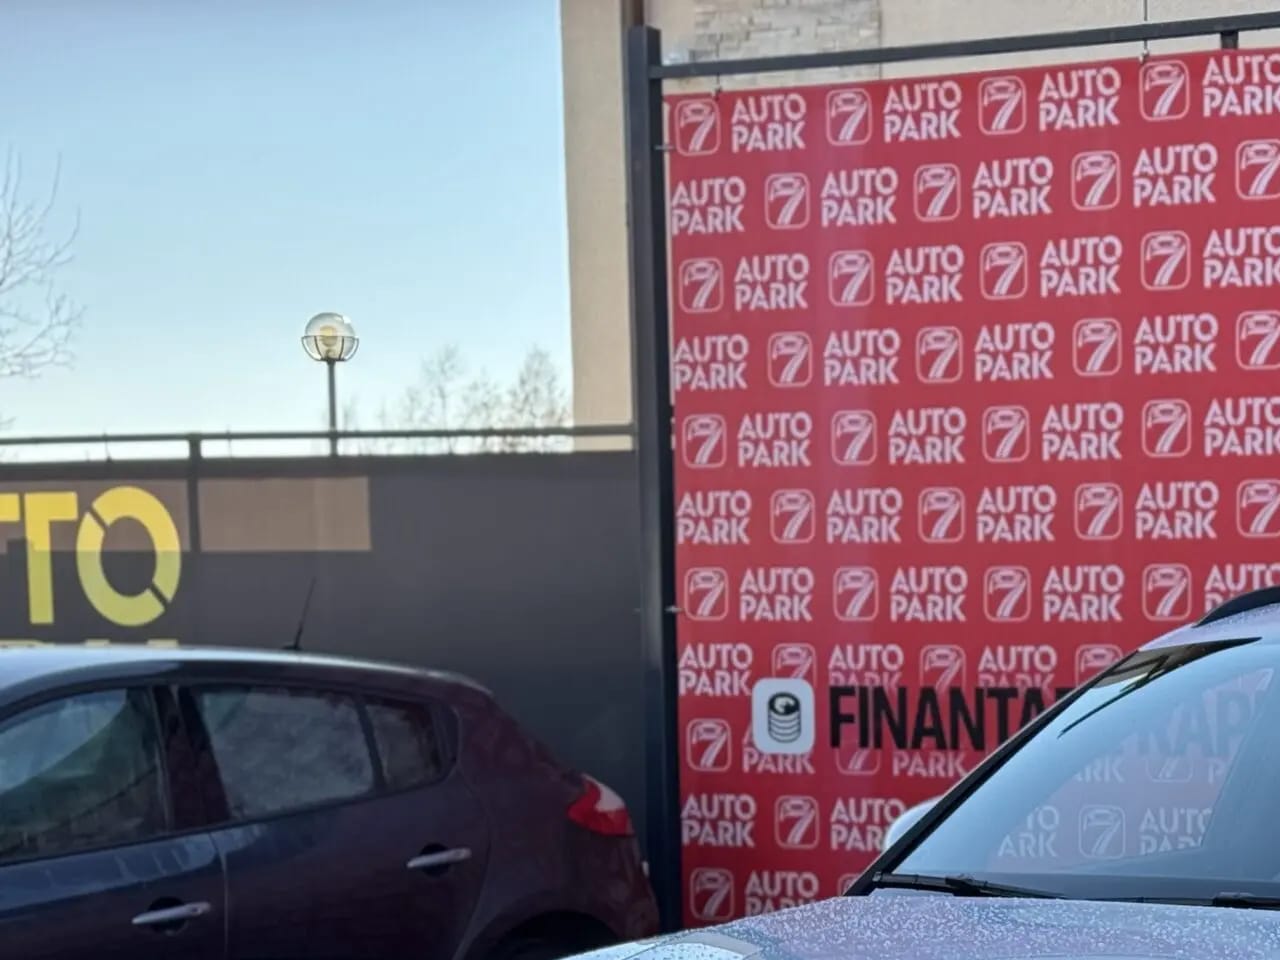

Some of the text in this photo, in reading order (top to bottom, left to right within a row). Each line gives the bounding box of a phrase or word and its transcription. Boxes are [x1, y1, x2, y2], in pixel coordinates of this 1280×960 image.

[883, 80, 962, 113] AUTO
[1038, 66, 1121, 102] AUTO
[731, 93, 806, 124] AUTO
[1039, 95, 1120, 132] PARK
[732, 120, 805, 153] PARK
[884, 109, 961, 143] PARK
[972, 155, 1054, 189] AUTO
[1132, 142, 1218, 177] AUTO
[672, 176, 746, 208] AUTO
[820, 166, 898, 199] AUTO
[1133, 173, 1216, 208] PARK
[821, 194, 896, 228] PARK
[973, 185, 1052, 219] PARK
[672, 204, 744, 235] PARK
[885, 244, 965, 276] AUTO
[1040, 235, 1123, 268] AUTO
[734, 253, 810, 284] AUTO
[1040, 264, 1121, 298] PARK
[735, 280, 808, 311] PARK
[886, 274, 963, 305] PARK
[823, 328, 901, 358] AUTO
[974, 321, 1055, 353] AUTO
[1133, 312, 1219, 345] AUTO
[675, 334, 749, 364] AUTO
[1134, 341, 1216, 375] PARK
[675, 362, 747, 391] PARK
[824, 356, 899, 386] PARK
[975, 349, 1054, 382] PARK
[737, 411, 812, 440] AUTO
[888, 406, 967, 437] AUTO
[1041, 401, 1124, 433] AUTO
[738, 439, 811, 467] PARK
[889, 434, 965, 465] PARK
[1042, 431, 1122, 461] PARK
[677, 490, 752, 518] AUTO
[826, 487, 903, 516] AUTO
[976, 484, 1057, 515] AUTO
[1135, 480, 1220, 511] AUTO
[677, 517, 750, 545] PARK
[827, 514, 901, 544] PARK
[976, 510, 1055, 543] PARK
[1135, 509, 1217, 540] PARK
[739, 567, 815, 595] AUTO
[890, 565, 968, 595] AUTO
[1042, 564, 1125, 594] AUTO
[740, 593, 812, 622] PARK
[890, 593, 966, 622] PARK
[1043, 592, 1123, 622] PARK
[678, 643, 753, 670] AUTO
[828, 644, 904, 671] AUTO
[978, 645, 1058, 672] AUTO
[679, 669, 751, 697] PARK
[682, 793, 757, 820] AUTO
[683, 820, 755, 848] PARK
[831, 825, 890, 850] PAR
[745, 870, 819, 899] AUTO
